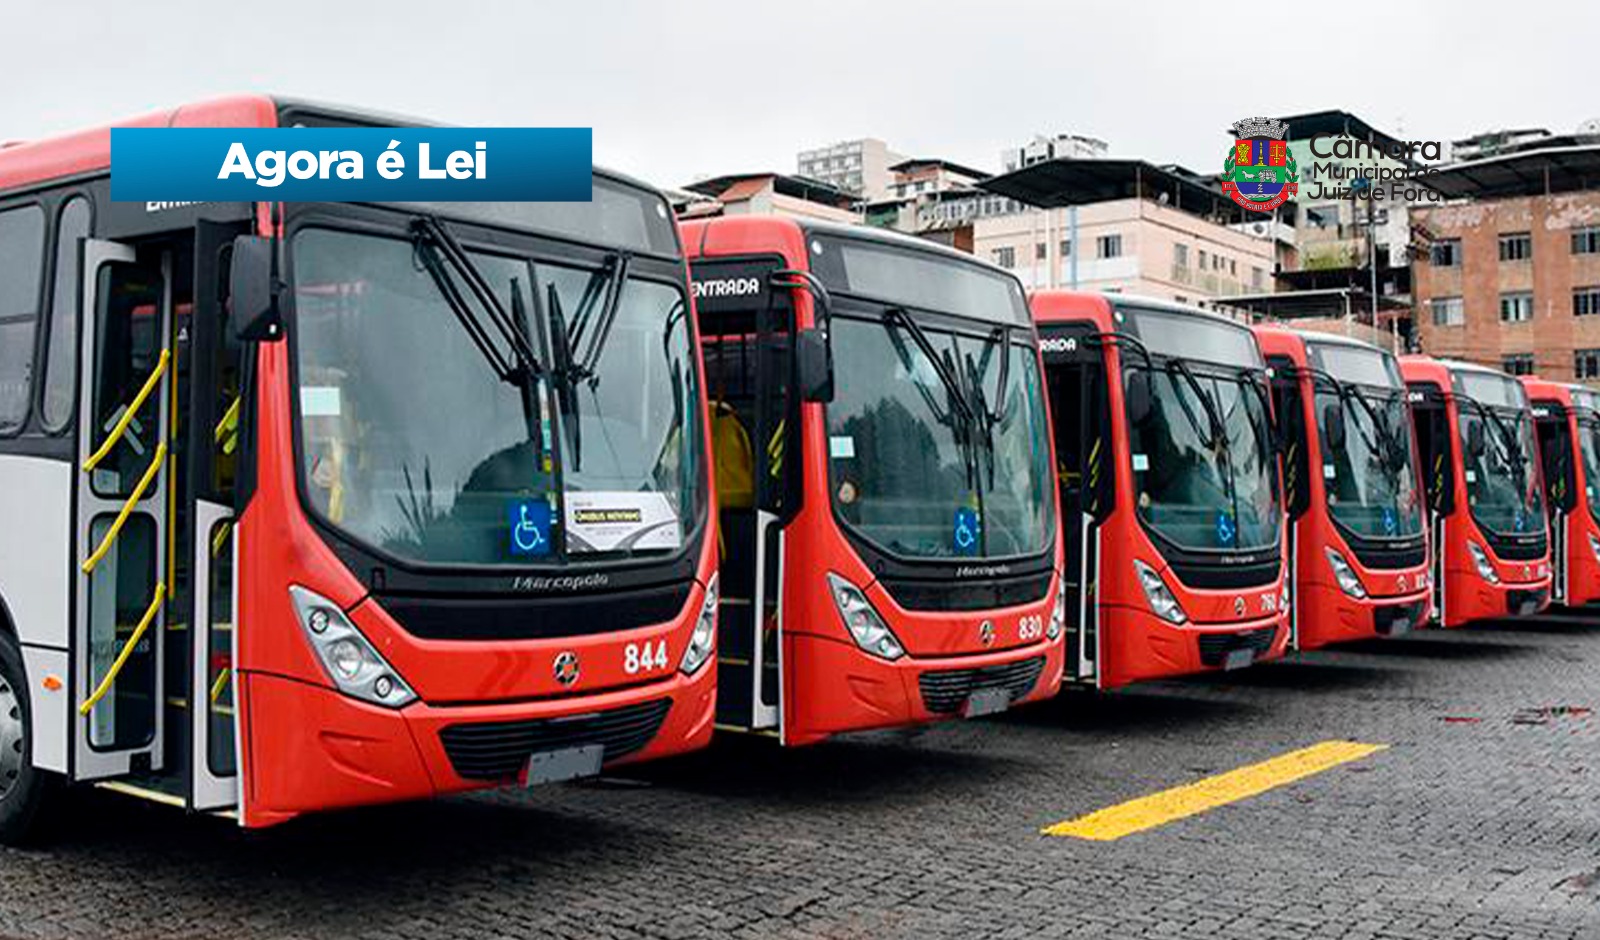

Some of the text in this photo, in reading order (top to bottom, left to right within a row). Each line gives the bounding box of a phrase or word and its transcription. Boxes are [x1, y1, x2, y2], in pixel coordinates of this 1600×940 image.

[513, 573, 609, 590] Marcopolo
[1018, 615, 1042, 640] 830
[624, 640, 668, 674] 844
